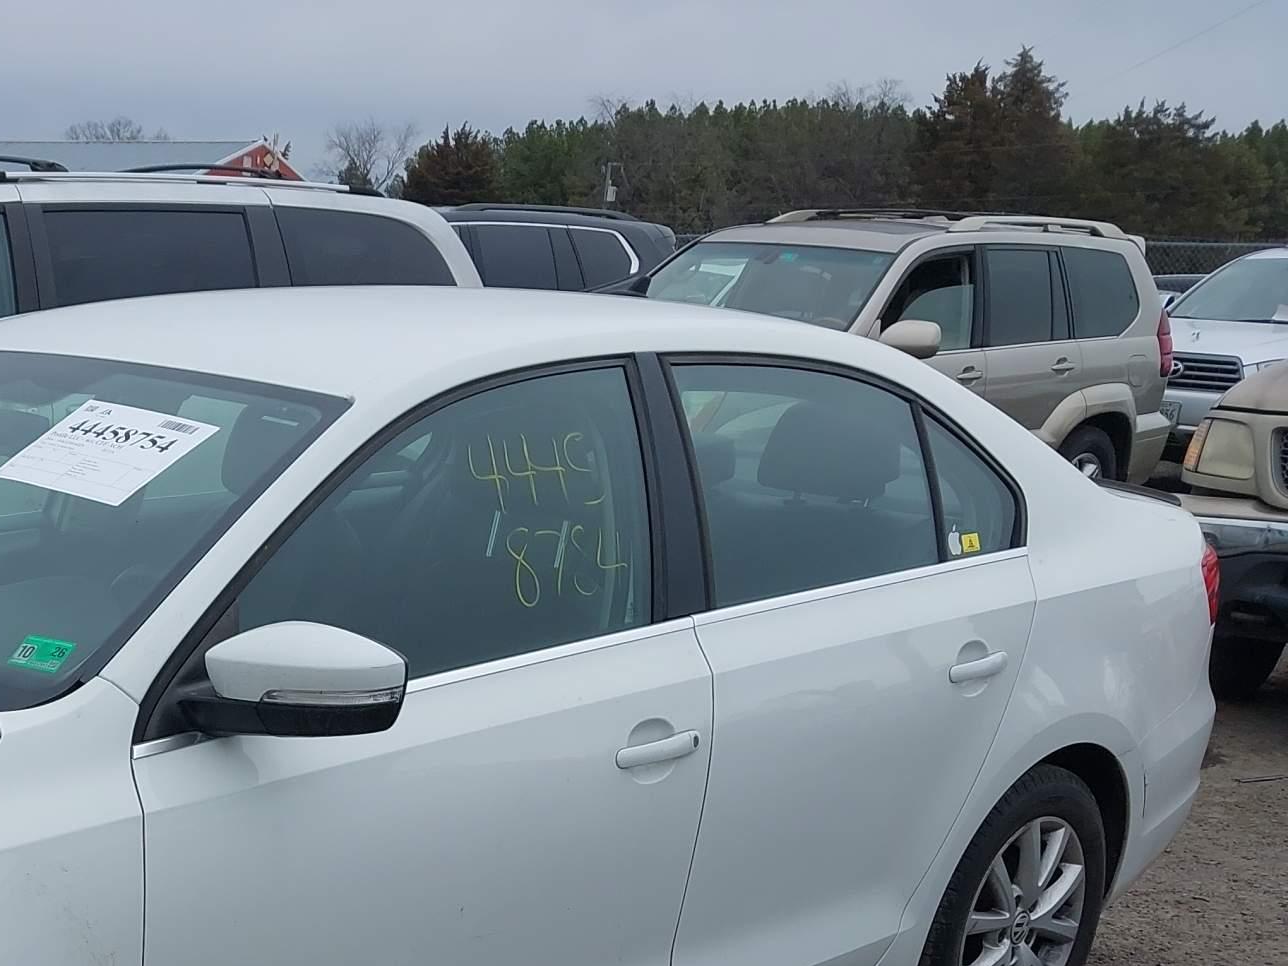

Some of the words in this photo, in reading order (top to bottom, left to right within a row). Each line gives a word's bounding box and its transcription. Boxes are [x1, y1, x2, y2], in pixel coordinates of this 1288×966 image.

[68, 419, 179, 453] 44458754
[17, 645, 36, 658] 10
[51, 646, 68, 658] 26
